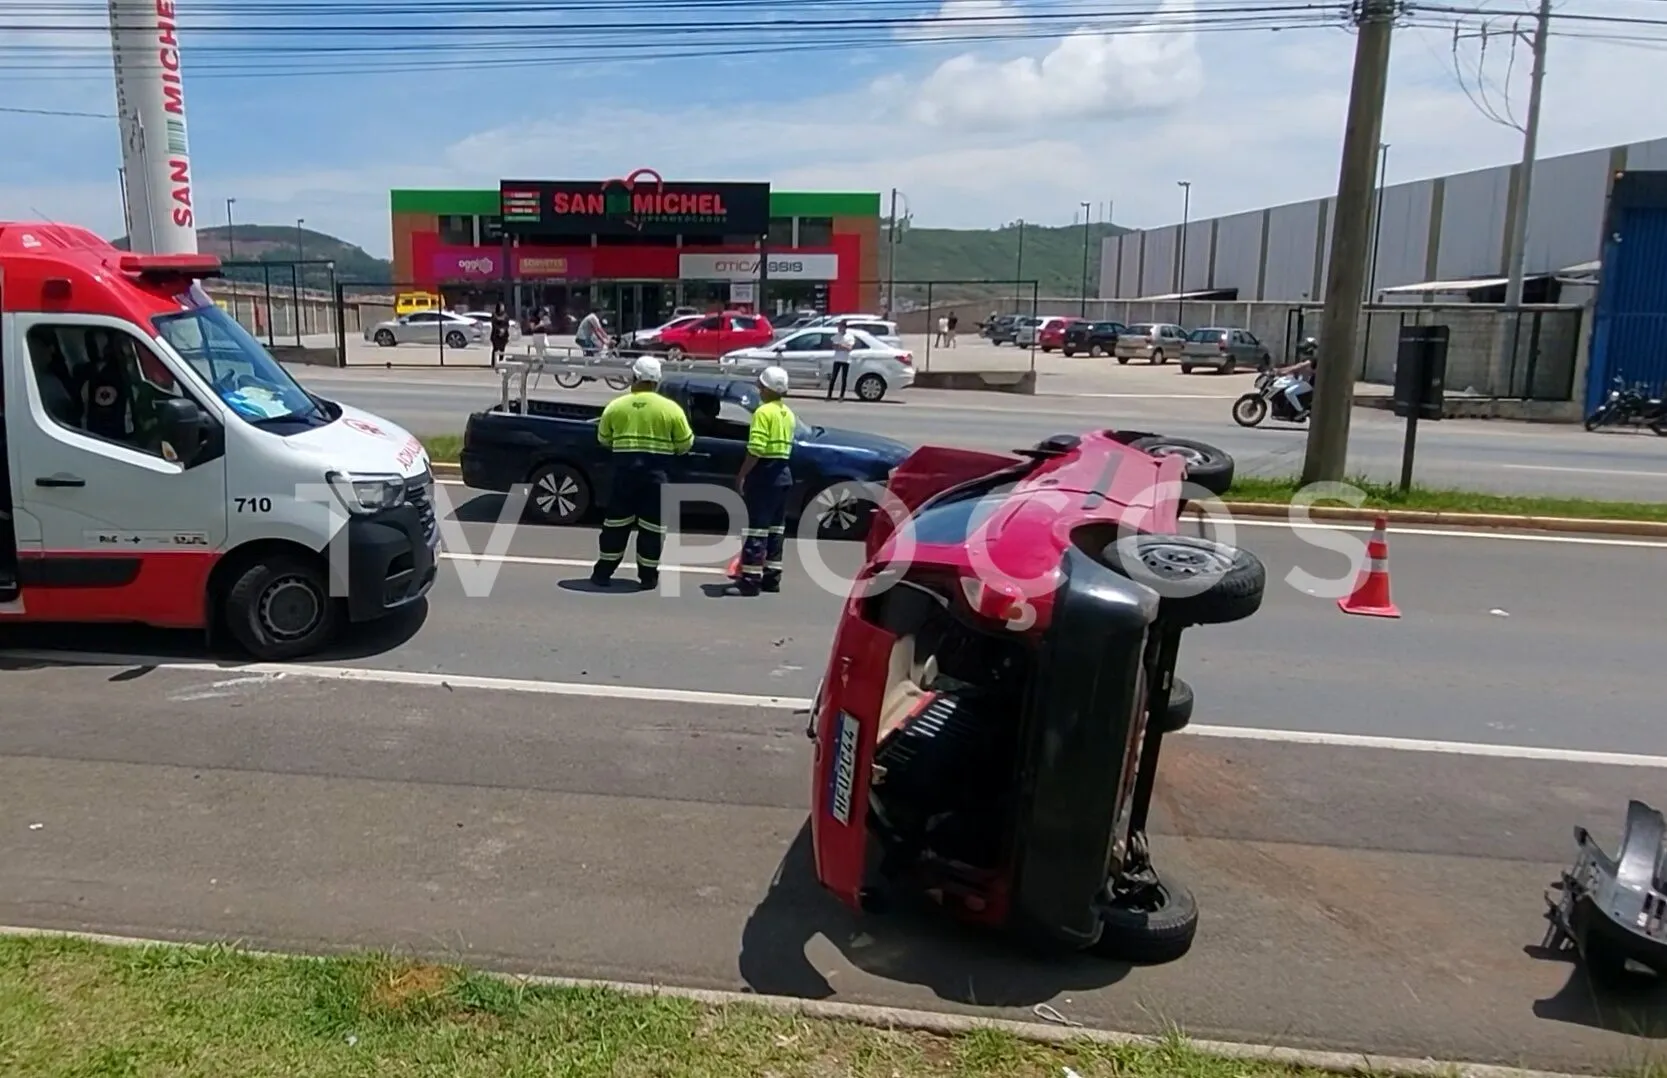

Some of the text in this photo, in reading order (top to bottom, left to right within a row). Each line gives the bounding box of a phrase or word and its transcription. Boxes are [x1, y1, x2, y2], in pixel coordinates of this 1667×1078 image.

[169, 159, 193, 227] SAN
[554, 192, 604, 214] SAN
[634, 192, 727, 214] MICHEL
[234, 497, 271, 513] 710
